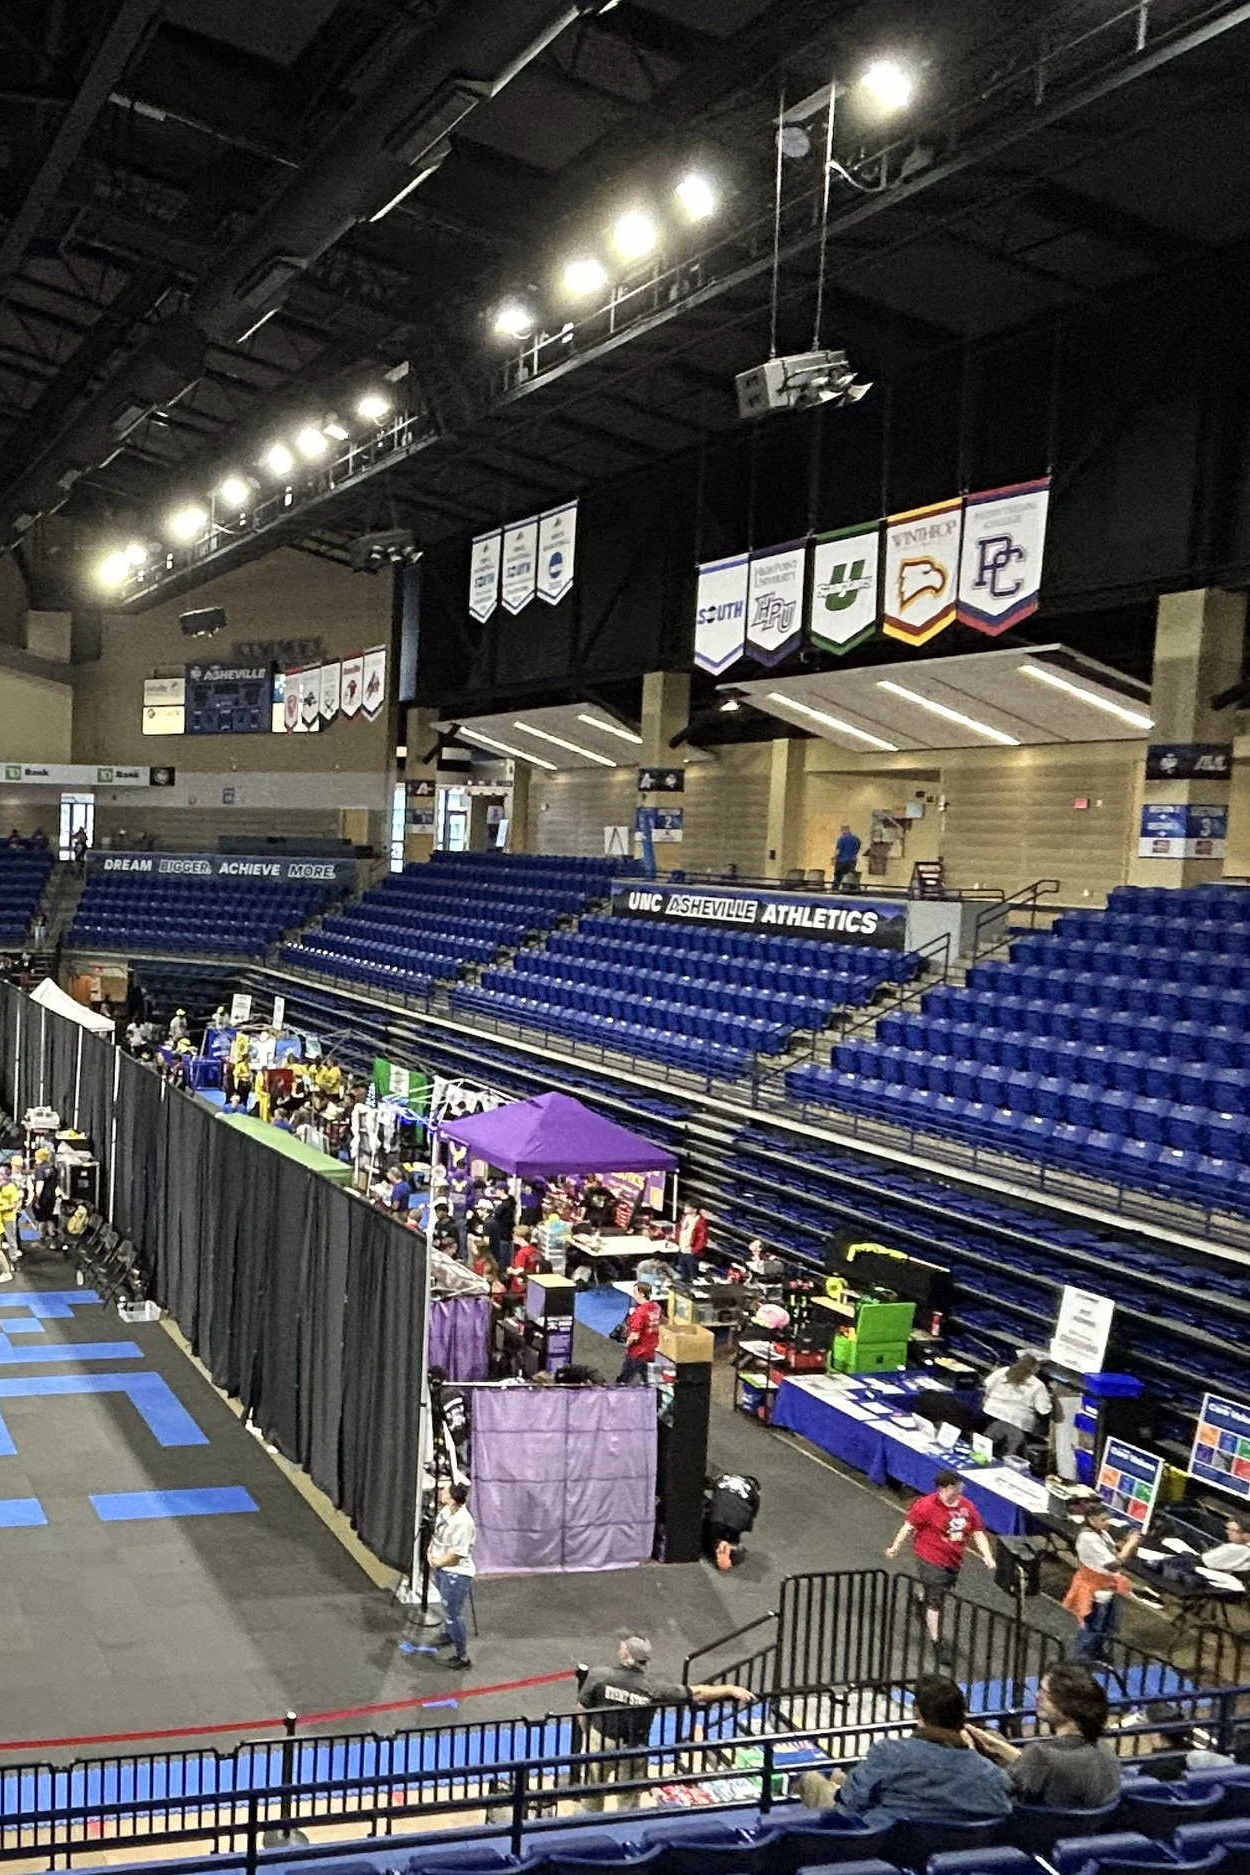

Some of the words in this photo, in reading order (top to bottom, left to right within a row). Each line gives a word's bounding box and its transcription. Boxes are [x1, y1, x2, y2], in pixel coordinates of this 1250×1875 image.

[891, 520, 957, 547] WINTHROP
[697, 600, 743, 624] SOUTH
[751, 591, 797, 633] HPU
[203, 667, 266, 681] ASHEVILLE
[24, 769, 49, 777] Bank
[104, 859, 152, 872] DREAM
[219, 862, 281, 876] ACHIEVE
[628, 891, 663, 912] UNC
[667, 895, 757, 922] ASHEVILLE
[761, 904, 878, 934] ATHLETICS
